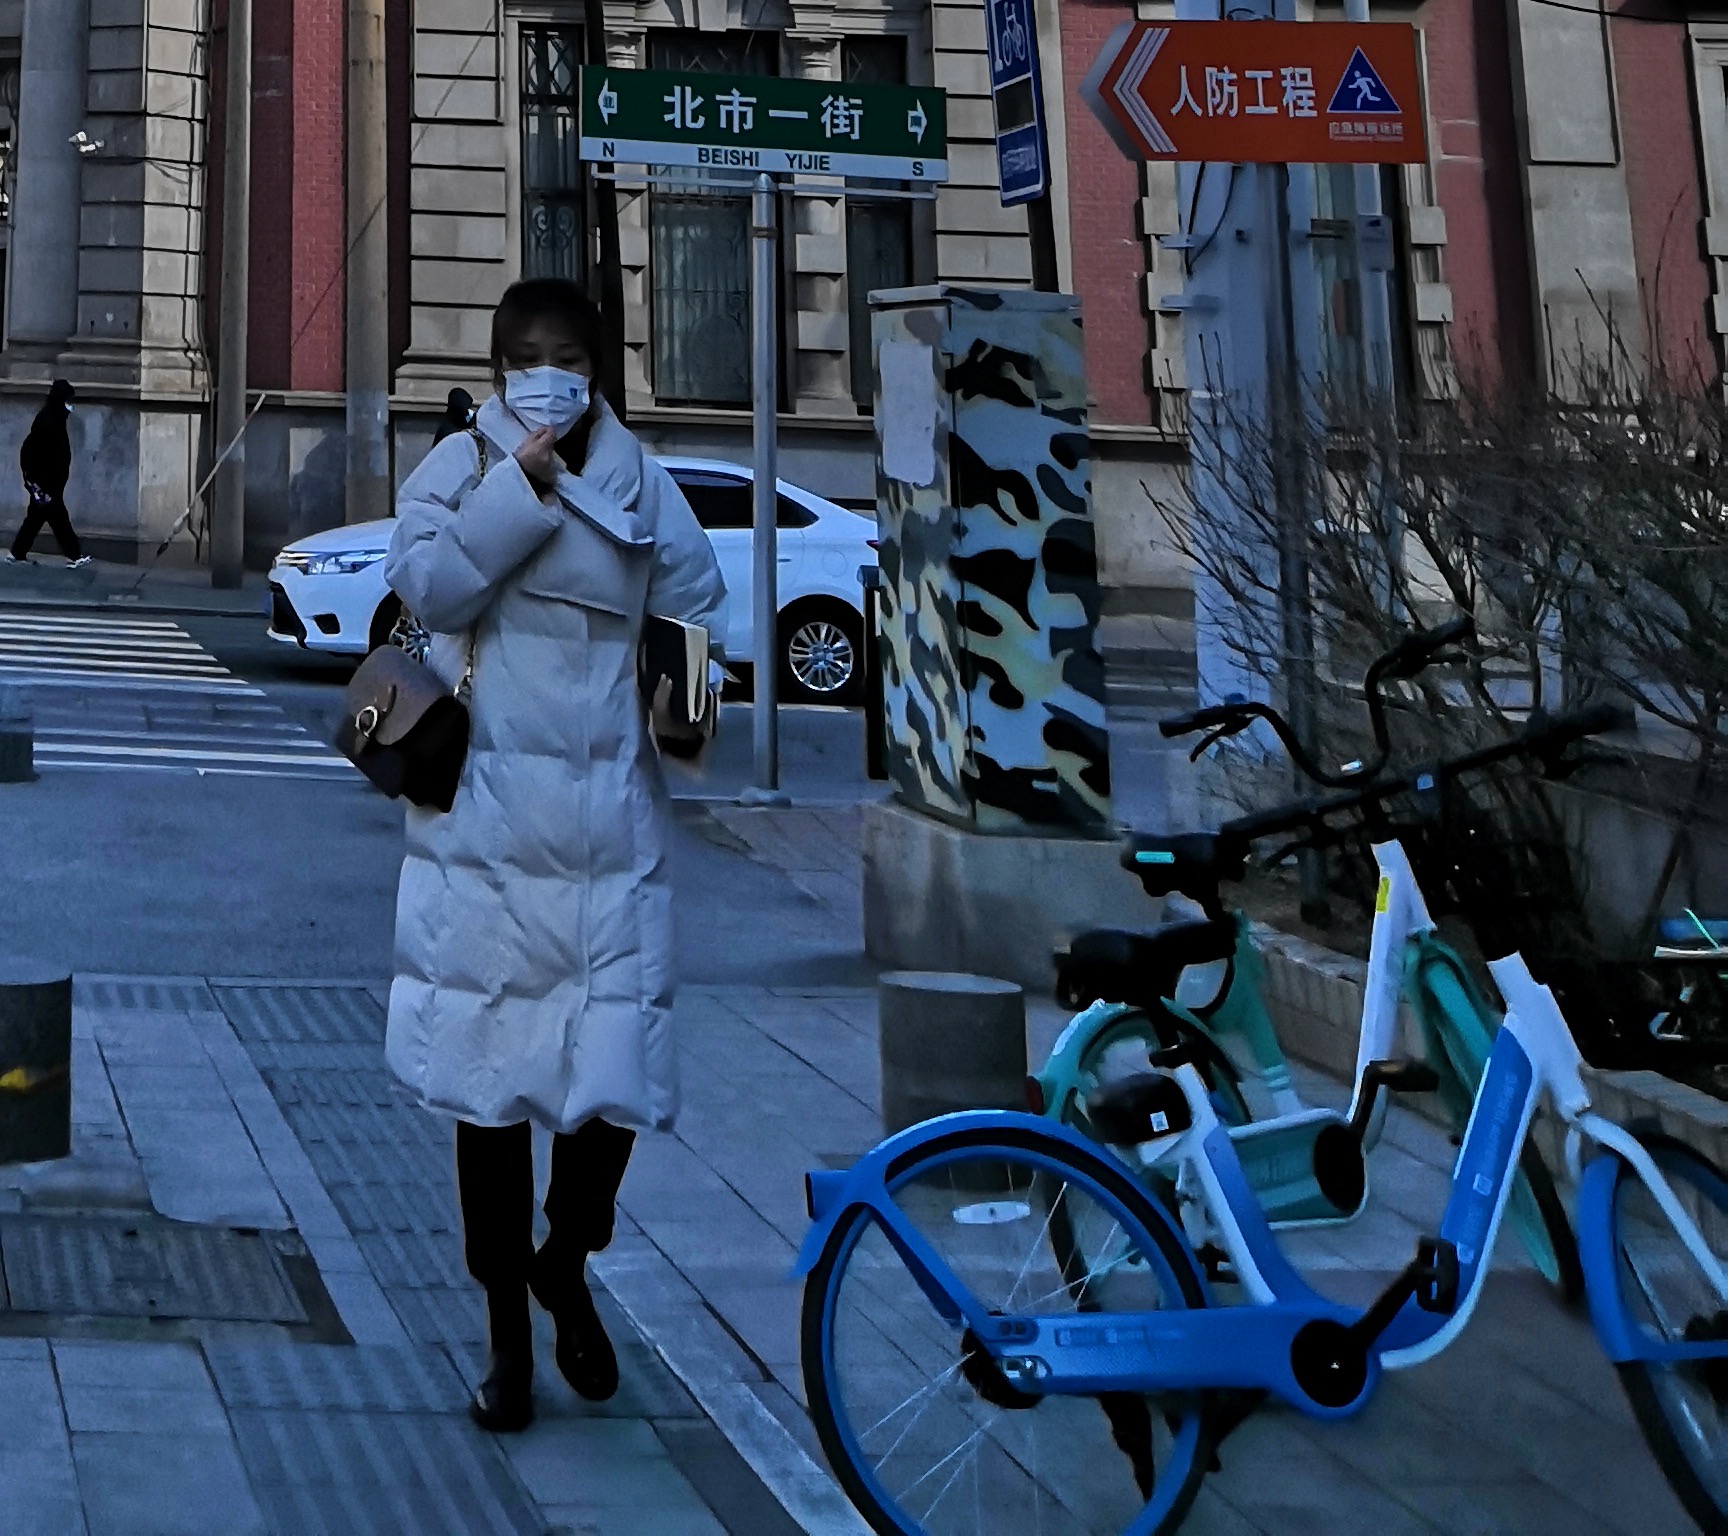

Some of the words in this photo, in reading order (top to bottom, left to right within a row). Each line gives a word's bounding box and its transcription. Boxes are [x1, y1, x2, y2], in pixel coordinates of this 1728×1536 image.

[1170, 64, 1318, 118] 人防工程
[663, 85, 864, 140] 北市一街
[603, 142, 615, 158] N
[698, 147, 760, 167] BEISHI
[785, 153, 831, 171] YIJIE
[912, 161, 924, 177] S
